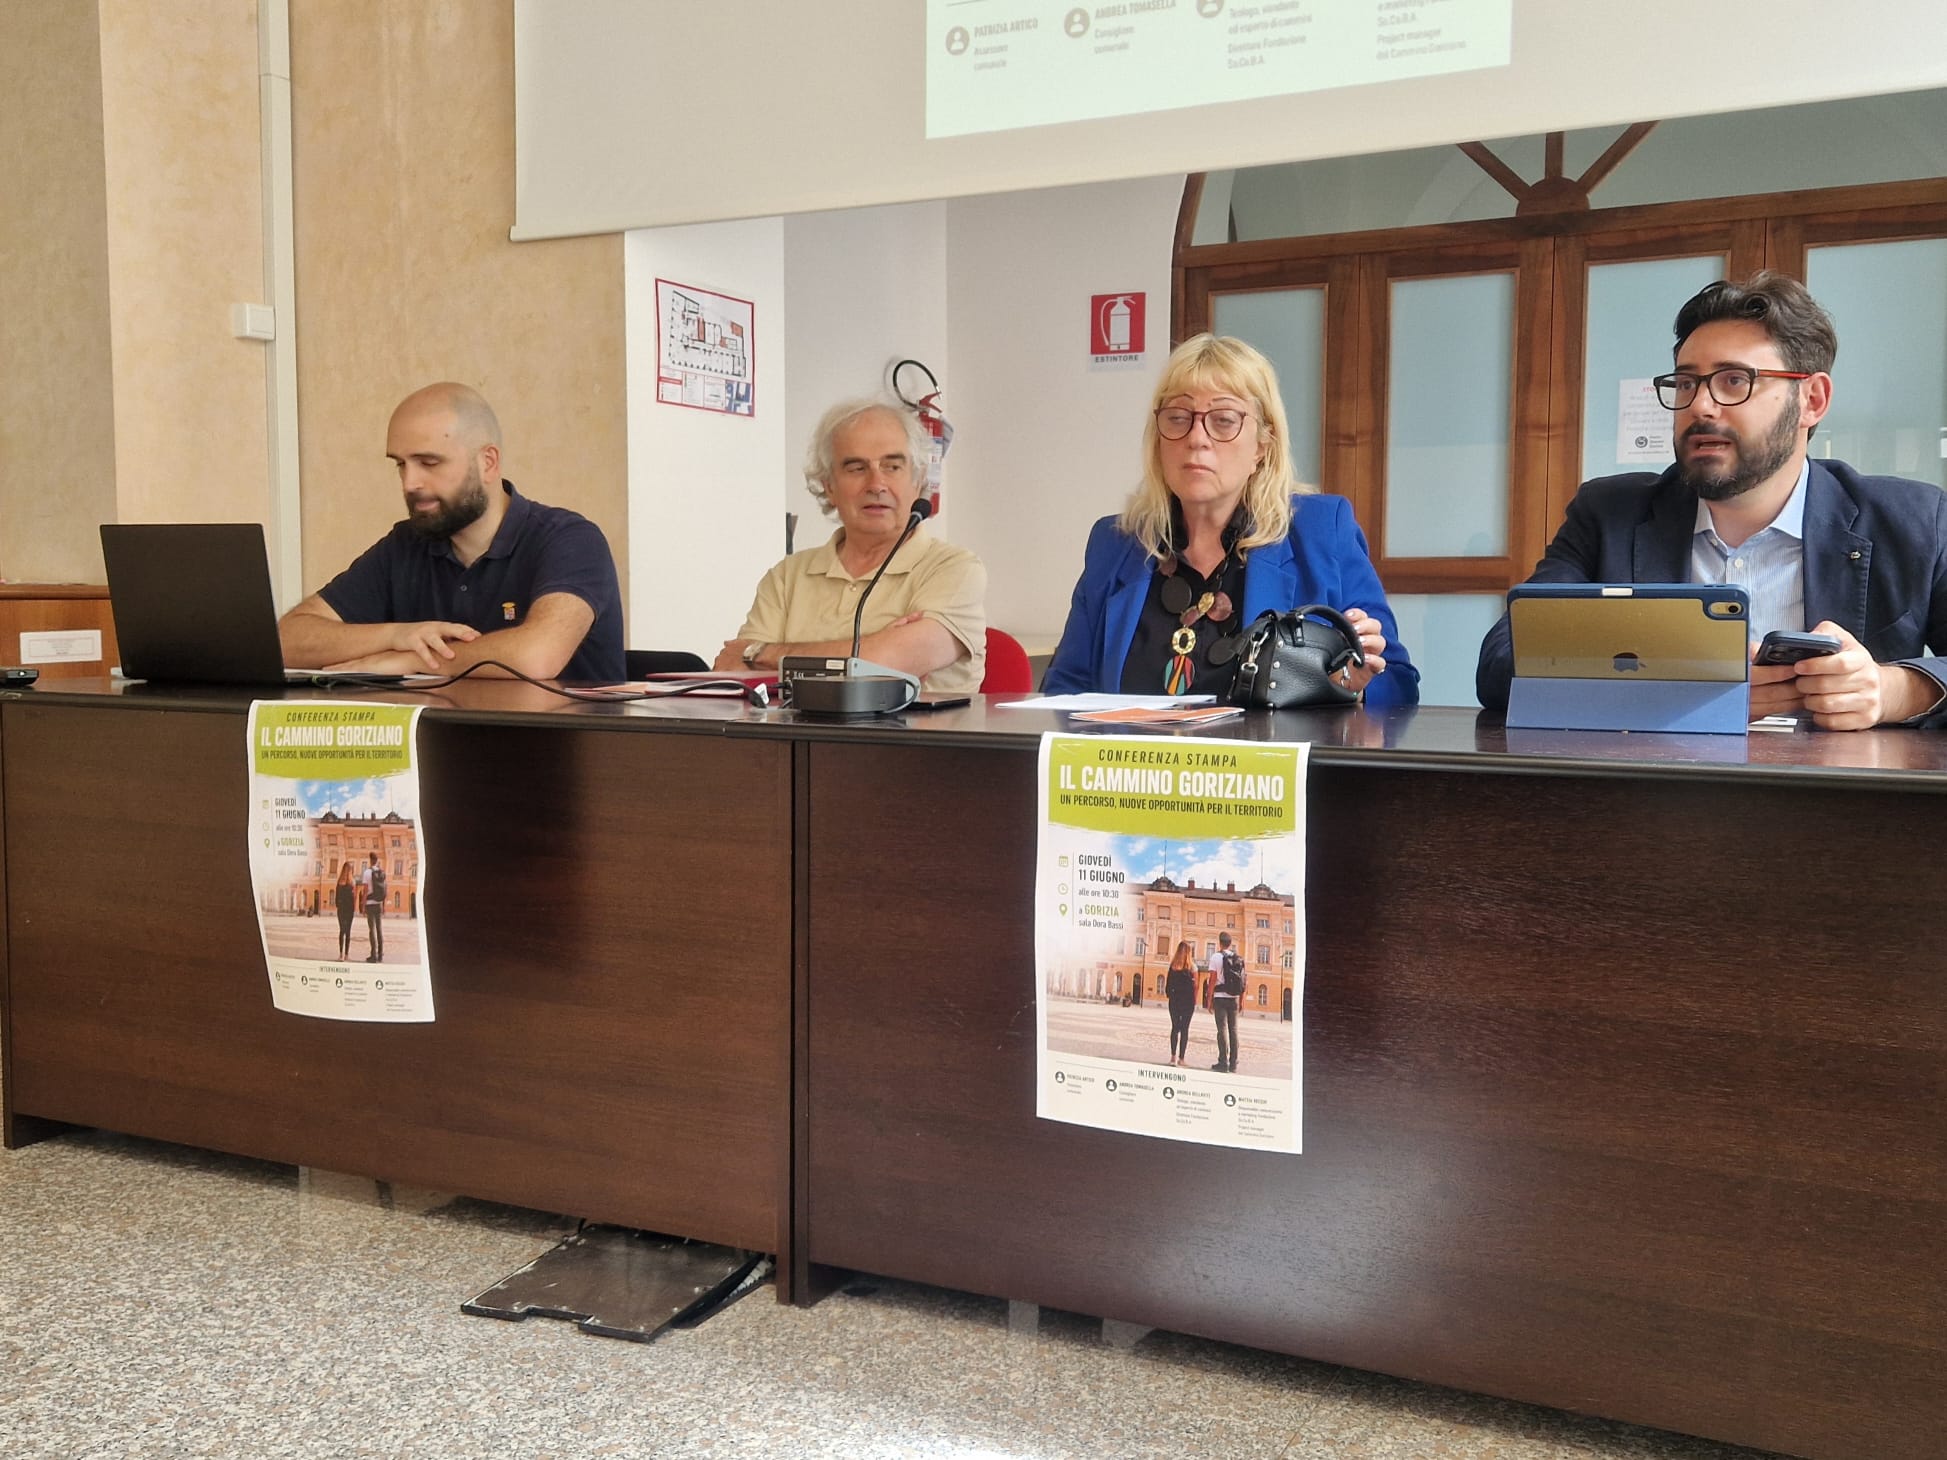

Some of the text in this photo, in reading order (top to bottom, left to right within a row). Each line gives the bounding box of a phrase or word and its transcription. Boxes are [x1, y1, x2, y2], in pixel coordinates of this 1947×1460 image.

[1095, 354, 1139, 363] ESTINTORE
[286, 711, 376, 722] CONFERENZA STAMPA
[261, 724, 403, 747] IL CAMMINO GORIZIANO
[1098, 749, 1237, 767] CONFERENZA STAMPA
[1060, 764, 1285, 802] IL CAMMINO GORIZIANO
[1060, 794, 1283, 818] UN PERCORSO, NUOVE OPPORTUNITÀ PER IL TERRITORIO
[276, 809, 306, 820] 11 GIUGNO
[1078, 854, 1111, 867] GIOVEDÌ
[1079, 869, 1125, 884] 11 GIUGNO
[1078, 888, 1089, 897] alle
[1090, 889, 1101, 898] ore
[1084, 903, 1119, 917] GORIZIA
[1078, 918, 1124, 930] sala Dora Bassi
[1137, 1068, 1187, 1083] INTERVENGONO
